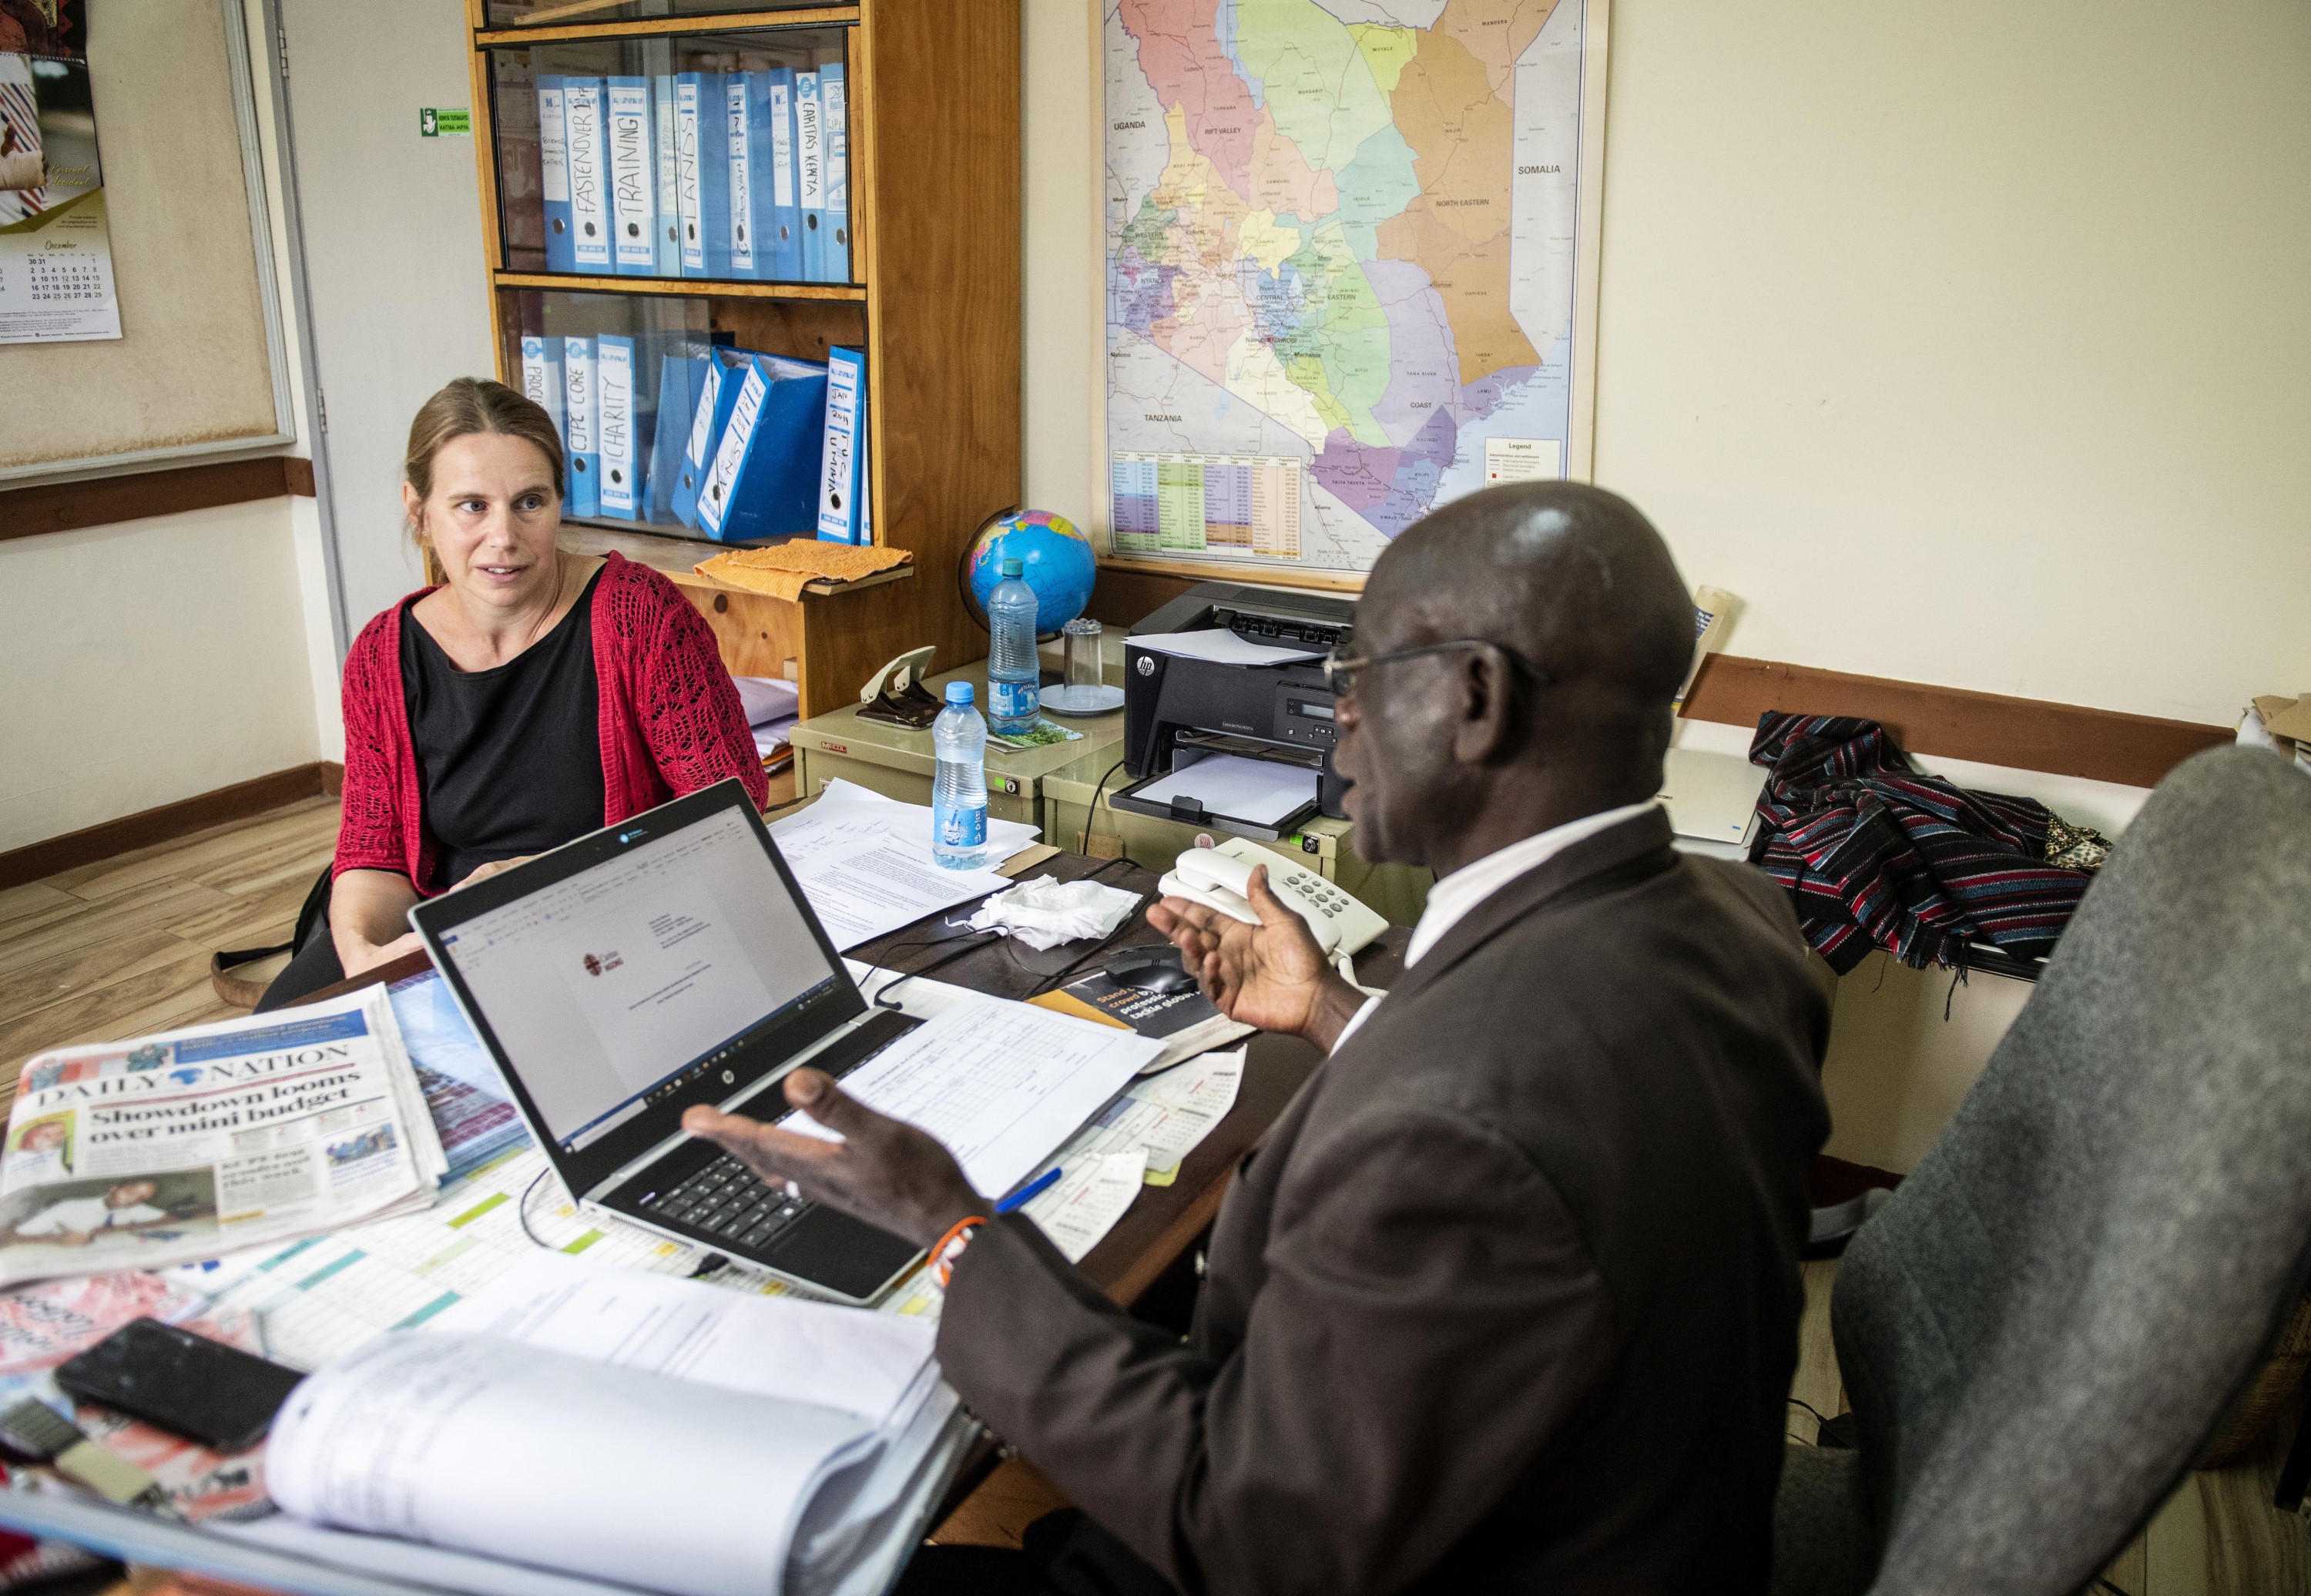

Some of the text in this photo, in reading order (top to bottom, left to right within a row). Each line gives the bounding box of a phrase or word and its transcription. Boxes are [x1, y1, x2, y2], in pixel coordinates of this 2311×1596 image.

[803, 102, 818, 149] CARITAS
[1114, 120, 1145, 130] UGANDA
[617, 117, 644, 216] TRAINING
[681, 118, 696, 220] LANDS
[1518, 165, 1561, 174] SOMALIA
[45, 240, 77, 250] December
[569, 367, 585, 404] CORE
[602, 376, 626, 458] CHARITY
[1140, 656, 1152, 676] hp
[1096, 988, 1127, 1003] Stand
[1109, 994, 1140, 1008] crowd
[1120, 994, 1169, 1014] professio
[1129, 1004, 1163, 1020] tackle
[39, 1044, 351, 1107] DAILY NATION
[90, 1069, 361, 1127] Showdown looms
[89, 1086, 351, 1145] over mini budget
[277, 1126, 287, 1135] 2
